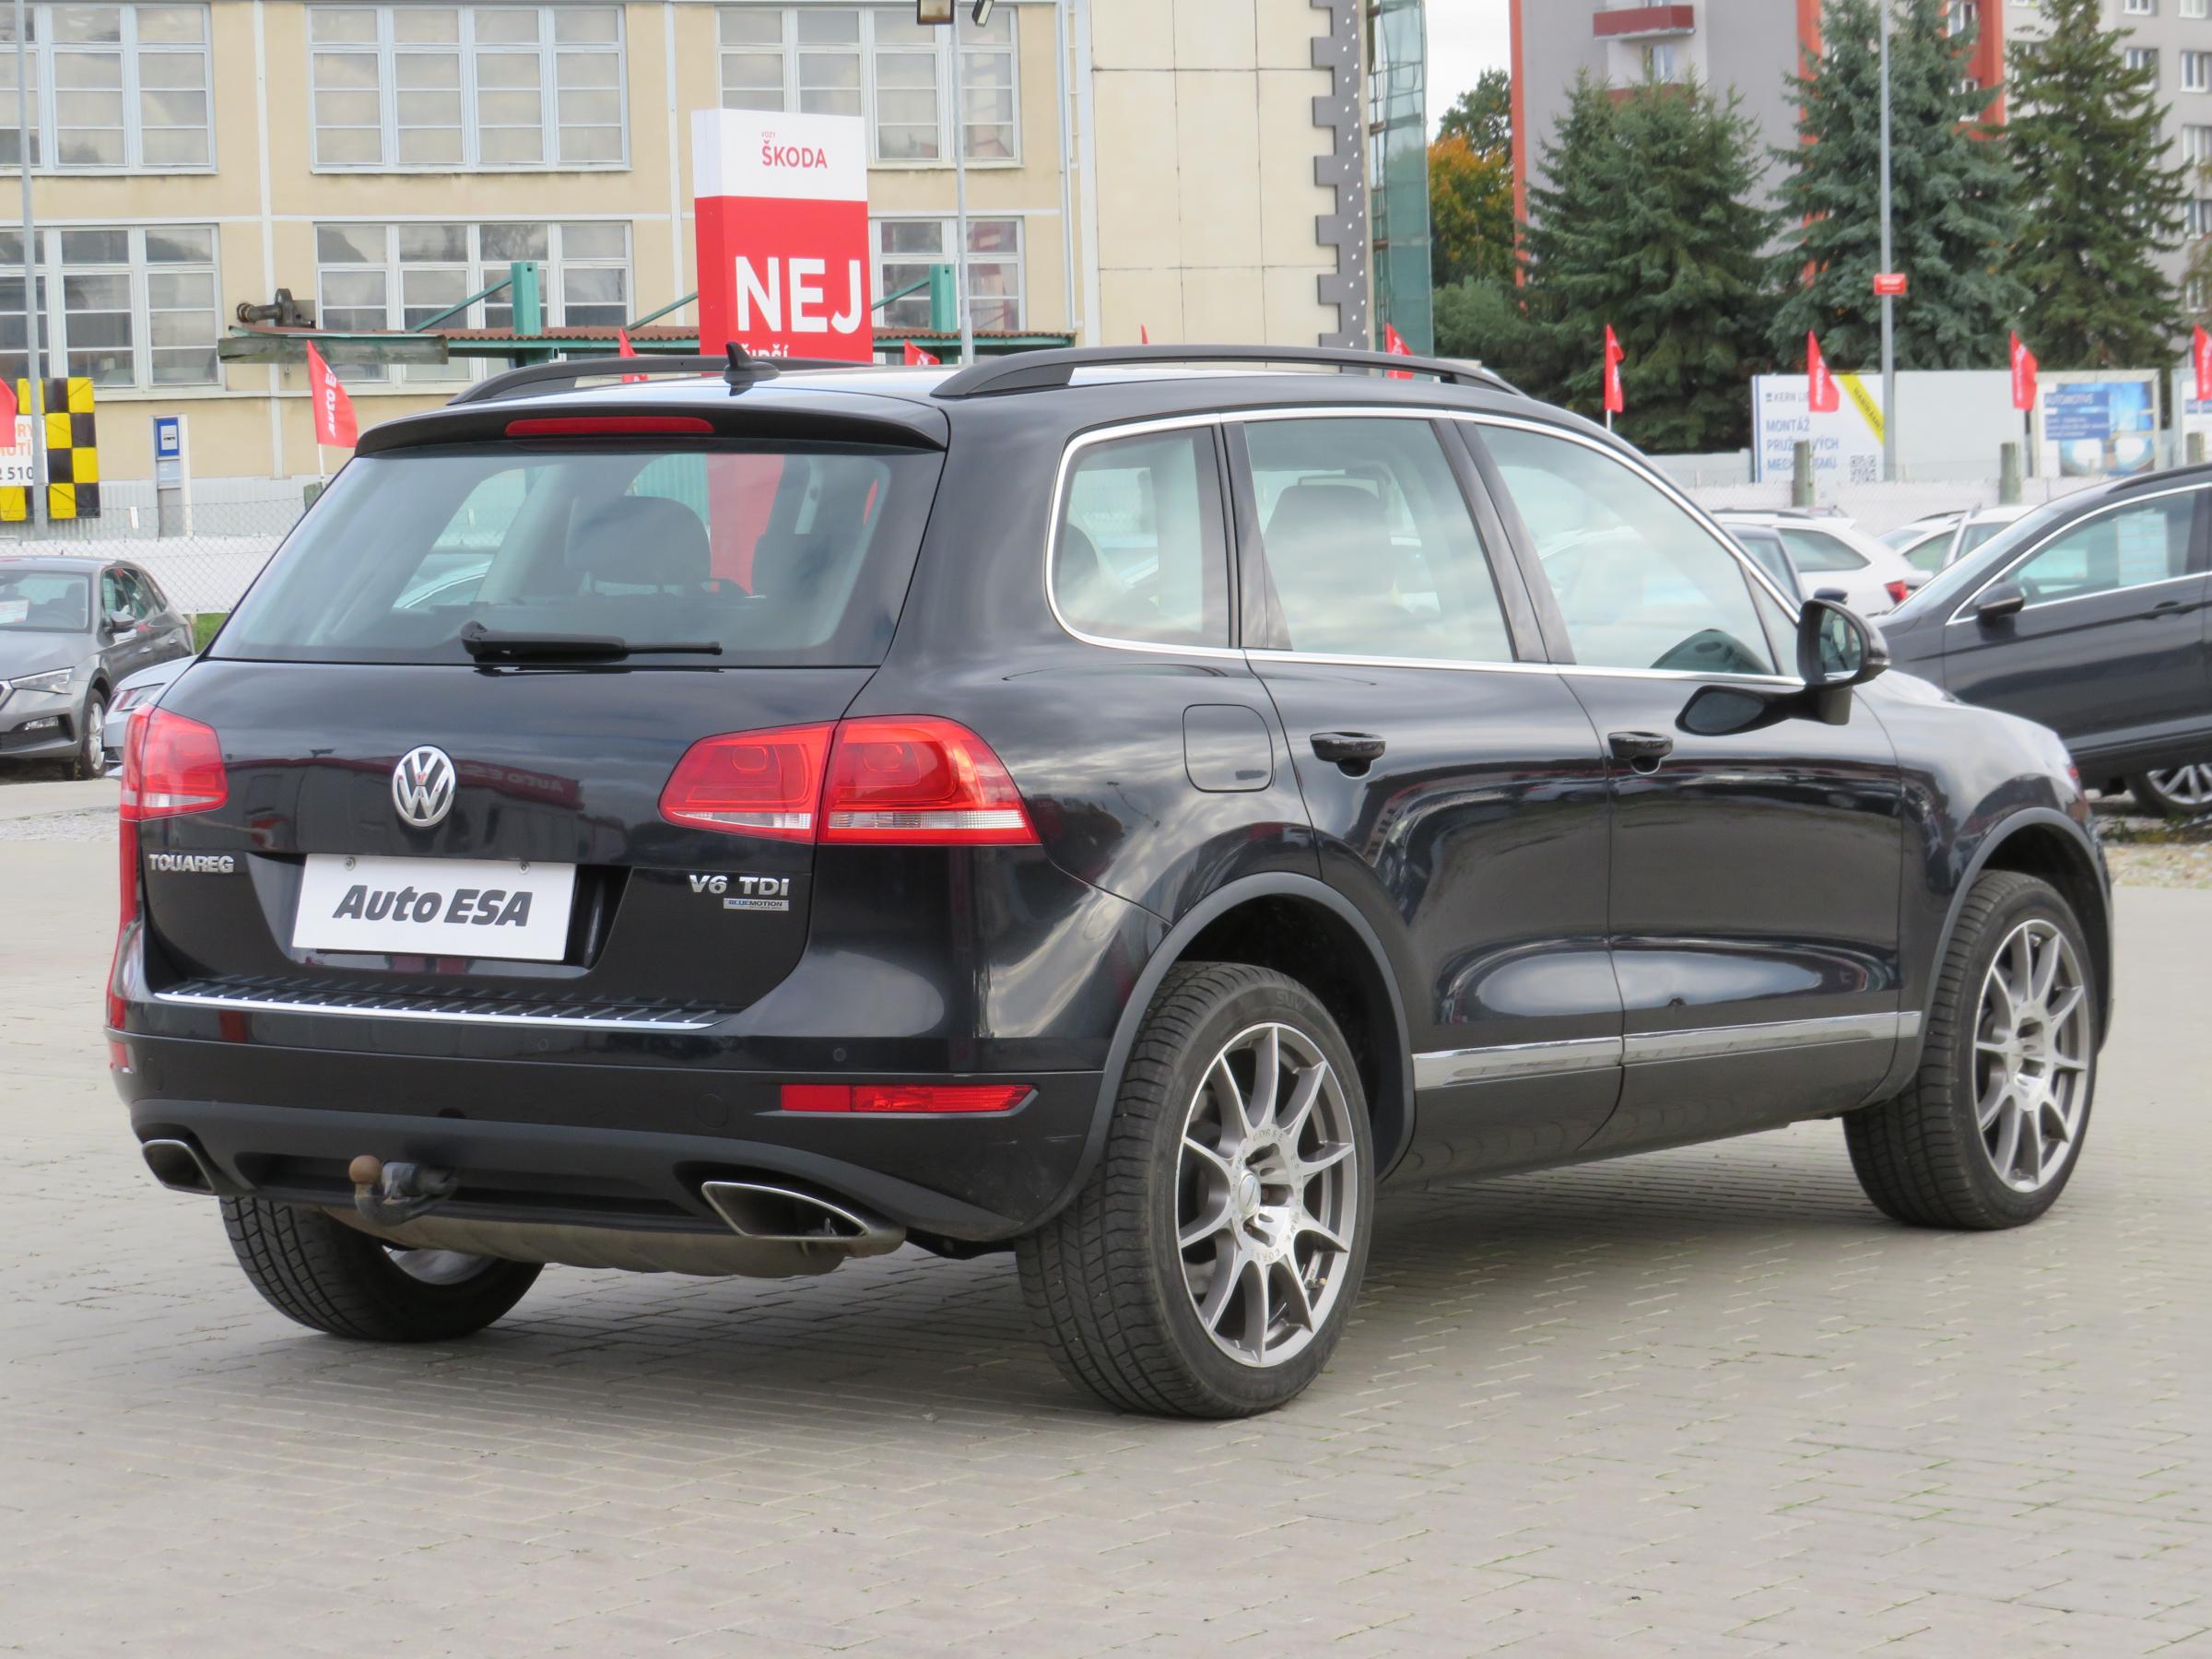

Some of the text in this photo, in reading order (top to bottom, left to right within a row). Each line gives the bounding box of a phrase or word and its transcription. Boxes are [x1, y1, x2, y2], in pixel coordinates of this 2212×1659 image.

[762, 139, 828, 169] ŠKODA
[735, 255, 862, 334] NEJ
[7, 465, 34, 480] 510
[148, 853, 234, 874] TOUAREG
[688, 874, 790, 896] V6 TDI
[332, 885, 534, 927] Auto ESA
[728, 899, 782, 907] BLUEMOTION
